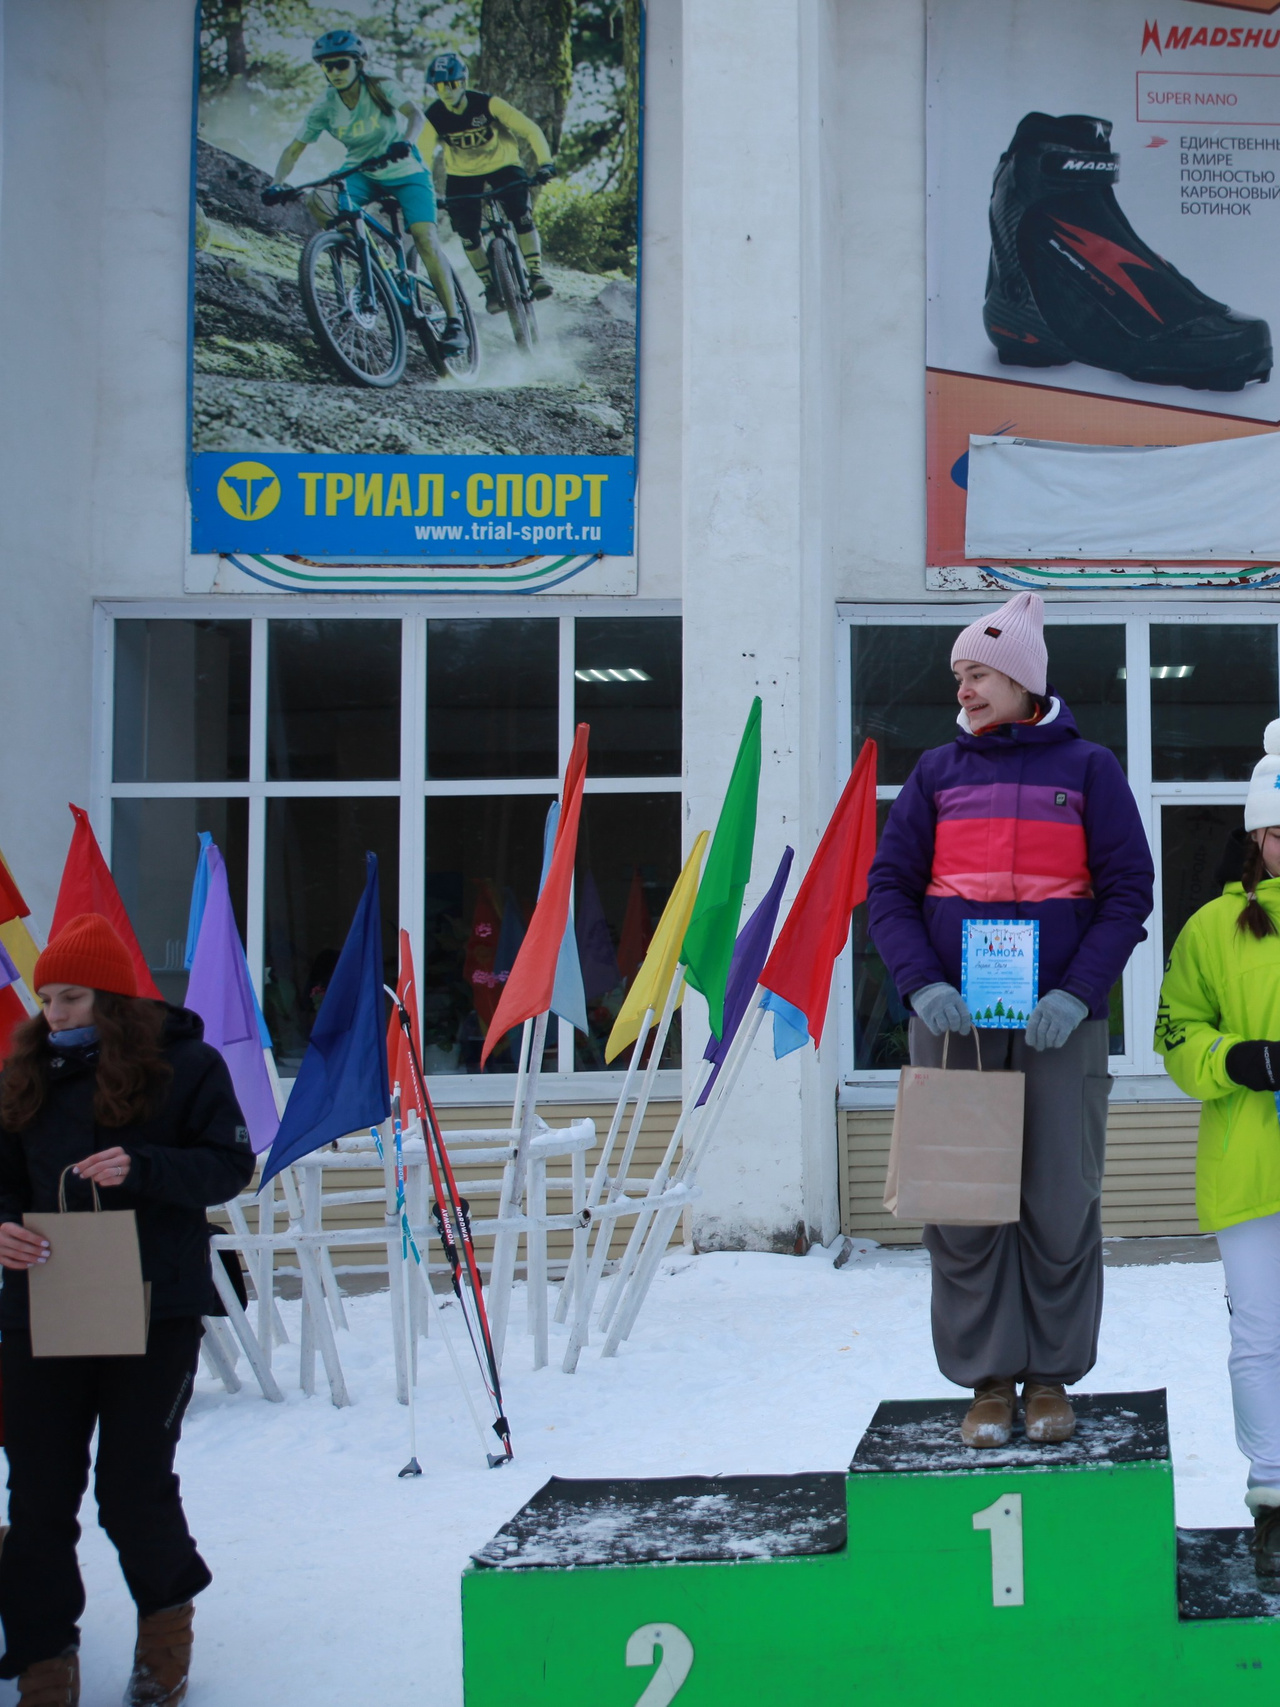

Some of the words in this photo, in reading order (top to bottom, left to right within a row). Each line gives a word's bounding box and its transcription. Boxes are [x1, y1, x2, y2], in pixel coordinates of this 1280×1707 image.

[1147, 91, 1191, 105] SUPER
[1195, 93, 1238, 106] NANO
[338, 115, 380, 139] FOX
[450, 128, 488, 148] FOX
[1180, 153, 1189, 165] В
[1193, 153, 1233, 166] МИРЕ
[1180, 169, 1275, 183] ПОЛНОСТЬЮ
[1181, 202, 1251, 215] БОТИНОК
[415, 522, 601, 544] www.trial-sport.ru
[975, 948, 1024, 957] ГРАМОТА
[1264, 1046, 1275, 1084] NORDSKI
[441, 1208, 454, 1245] NORDWAY
[455, 1206, 469, 1242] NORDWAY
[972, 1493, 1024, 1608] 1
[626, 1622, 694, 1707] 2
